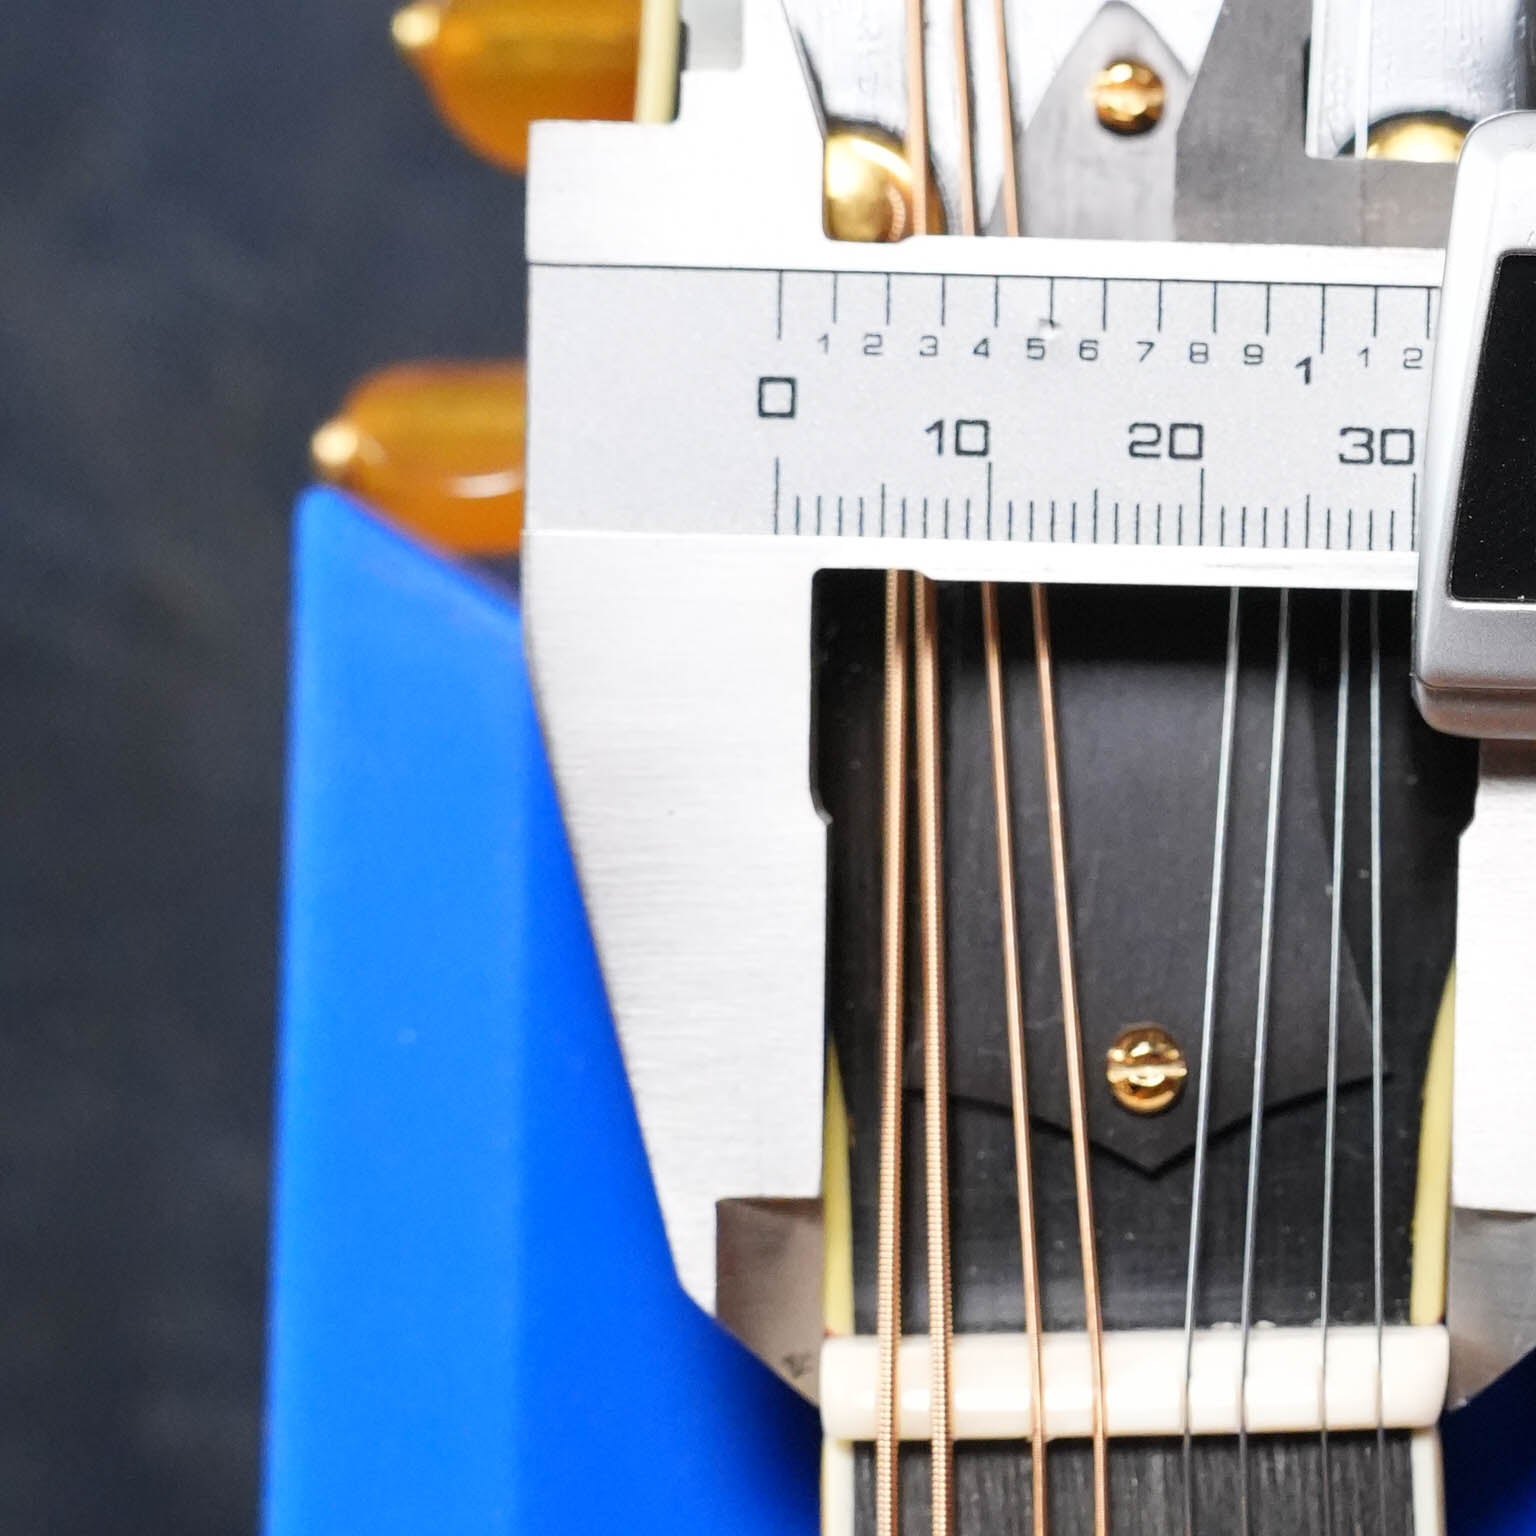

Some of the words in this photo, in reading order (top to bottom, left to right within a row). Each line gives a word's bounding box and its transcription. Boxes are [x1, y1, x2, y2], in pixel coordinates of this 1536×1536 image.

[817, 332, 830, 354] 1
[862, 332, 883, 356] 2
[918, 334, 939, 358] 3
[972, 337, 990, 359] 4
[1026, 337, 1046, 361] 5
[1078, 339, 1099, 362] 6
[1135, 340, 1156, 363] 7
[1188, 341, 1209, 365] 8
[1243, 343, 1264, 366] 9
[1295, 356, 1312, 385] 1
[1358, 346, 1370, 369] 1
[1402, 347, 1423, 370] 2
[757, 376, 797, 420] 0
[925, 418, 991, 458] 10
[1128, 422, 1204, 461] 20
[1338, 426, 1416, 466] 30
